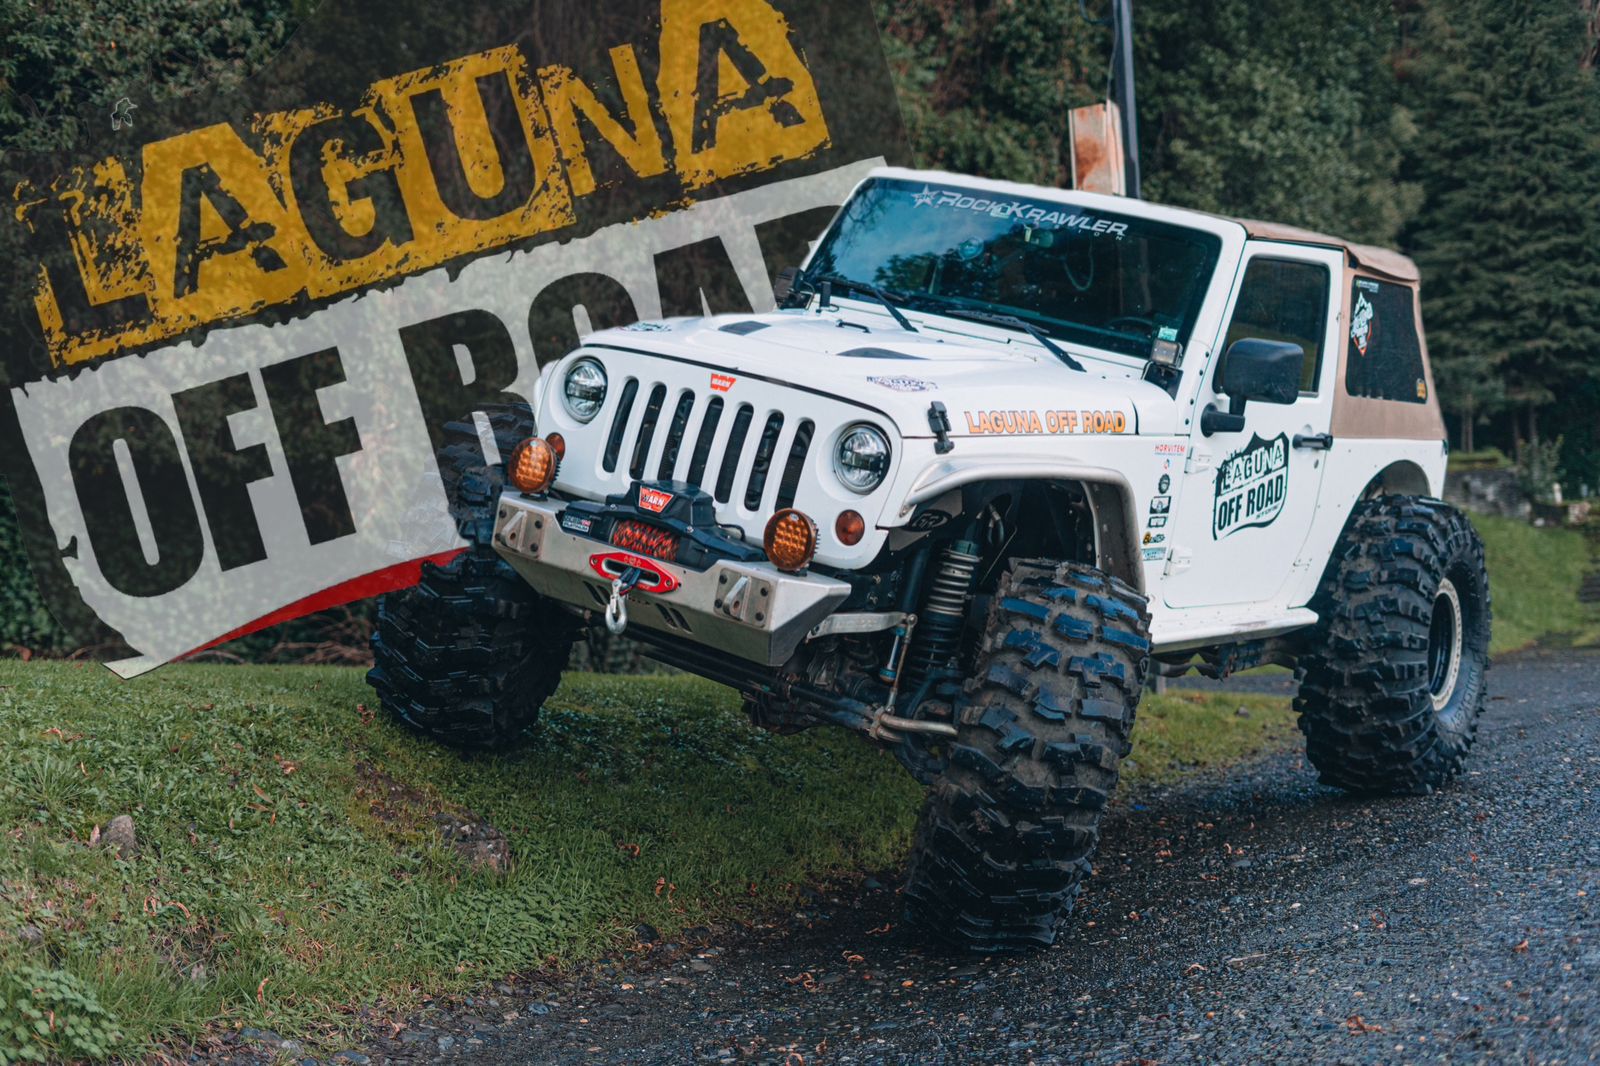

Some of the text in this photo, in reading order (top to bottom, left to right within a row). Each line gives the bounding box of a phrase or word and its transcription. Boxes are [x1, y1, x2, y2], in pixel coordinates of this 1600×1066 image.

[964, 410, 1127, 434] LAGUNA OFF ROAD
[1219, 437, 1285, 492] LAGUNA
[1217, 493, 1244, 531] OFF
[1246, 473, 1285, 518] ROAD
